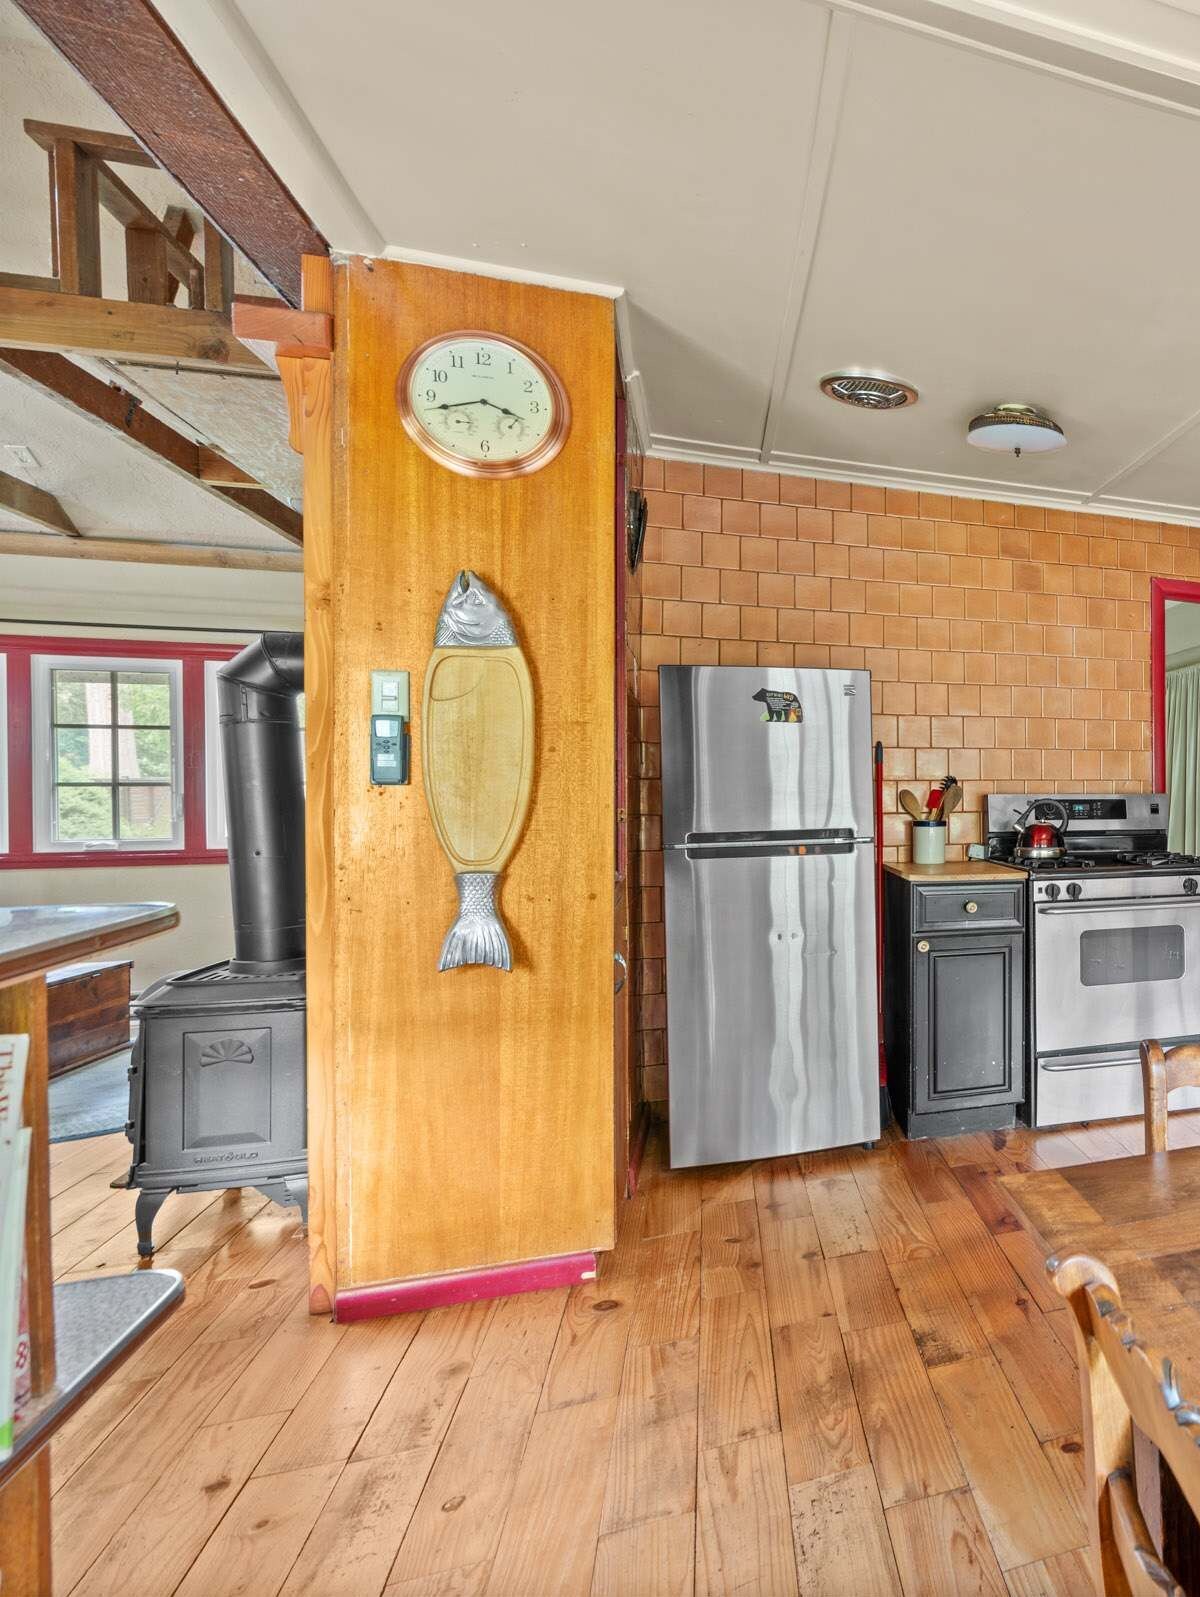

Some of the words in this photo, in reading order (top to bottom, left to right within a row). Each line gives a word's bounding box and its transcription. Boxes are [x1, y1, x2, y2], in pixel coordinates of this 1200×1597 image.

[450, 354, 464, 368] 11
[475, 352, 491, 366] 12
[507, 362, 513, 374] 1
[432, 370, 448, 383] 10
[523, 381, 533, 393] 2
[426, 389, 436, 402] 9
[529, 401, 540, 414] 3
[480, 440, 490, 453] 6
